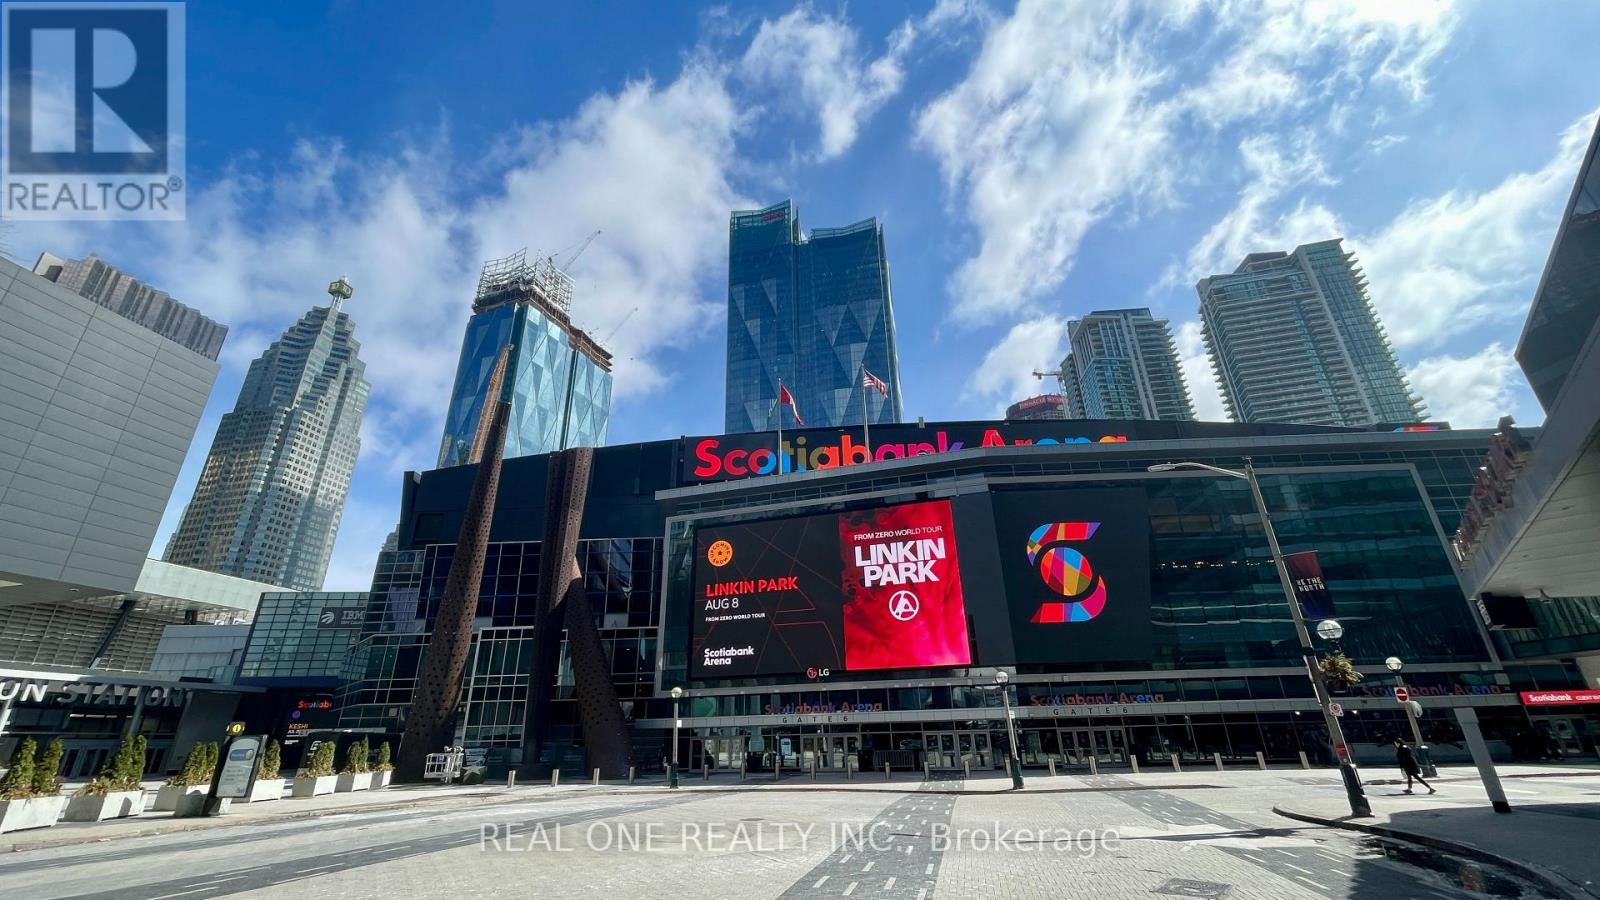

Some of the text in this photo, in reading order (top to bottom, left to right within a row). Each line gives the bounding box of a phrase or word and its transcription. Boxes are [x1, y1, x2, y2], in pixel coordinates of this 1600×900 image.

[854, 525, 943, 541] FROM ZERO WORLD TOUR
[854, 538, 946, 567] LINKIN
[863, 560, 940, 587] PARK
[706, 576, 798, 597] LINKIN PARK
[1298, 584, 1325, 592] NORTH
[704, 597, 740, 611] AUG 8
[703, 645, 755, 658] Scotiabank
[703, 657, 731, 666] Arena
[818, 668, 830, 677] LG
[57, 681, 186, 707] STATION
[1362, 684, 1448, 697] Scotbank
[1119, 692, 1164, 704] Arena
[1529, 693, 1573, 701] Scotiabank
[841, 701, 883, 713] Arena
[1053, 707, 1111, 716] GATE
[782, 715, 833, 724] GATE
